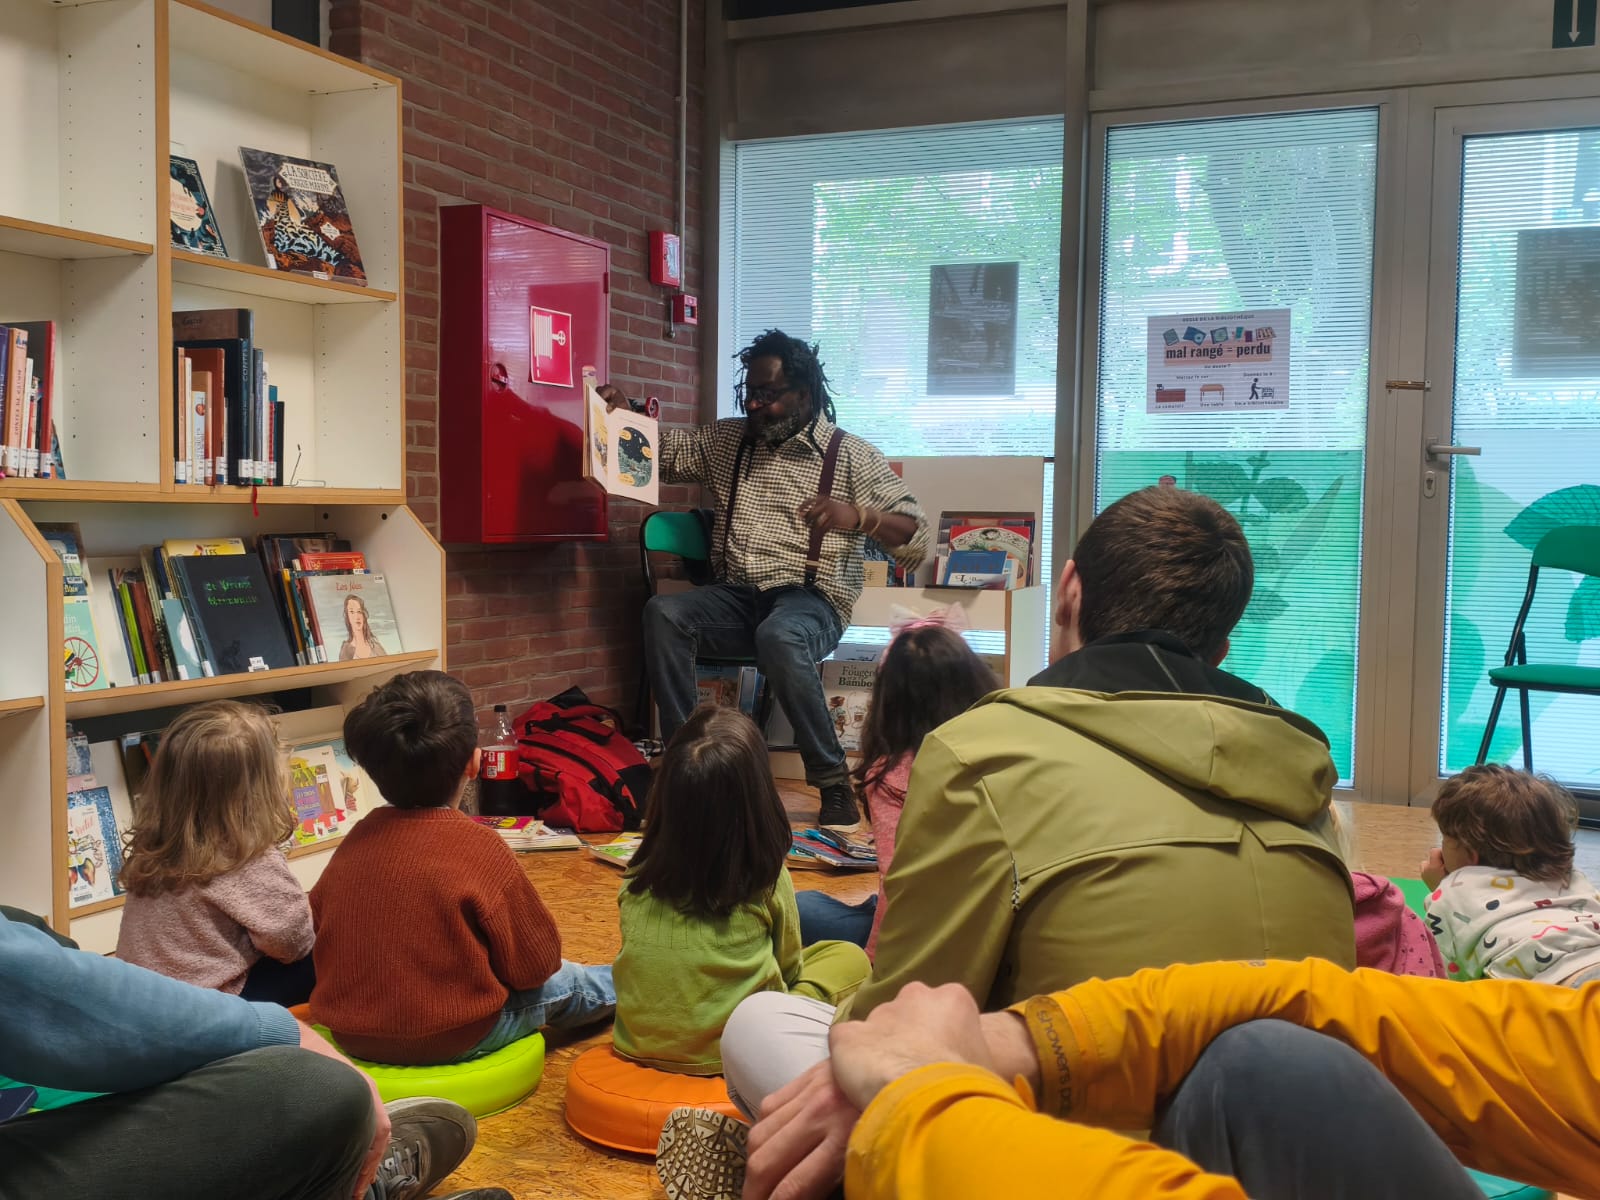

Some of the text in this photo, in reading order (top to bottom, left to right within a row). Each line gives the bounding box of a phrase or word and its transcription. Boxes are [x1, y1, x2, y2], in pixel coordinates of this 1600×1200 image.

[1166, 346, 1187, 359] mal
[1190, 343, 1223, 359] rangé
[1236, 342, 1271, 358] perdu
[839, 677, 873, 688] Bambo
